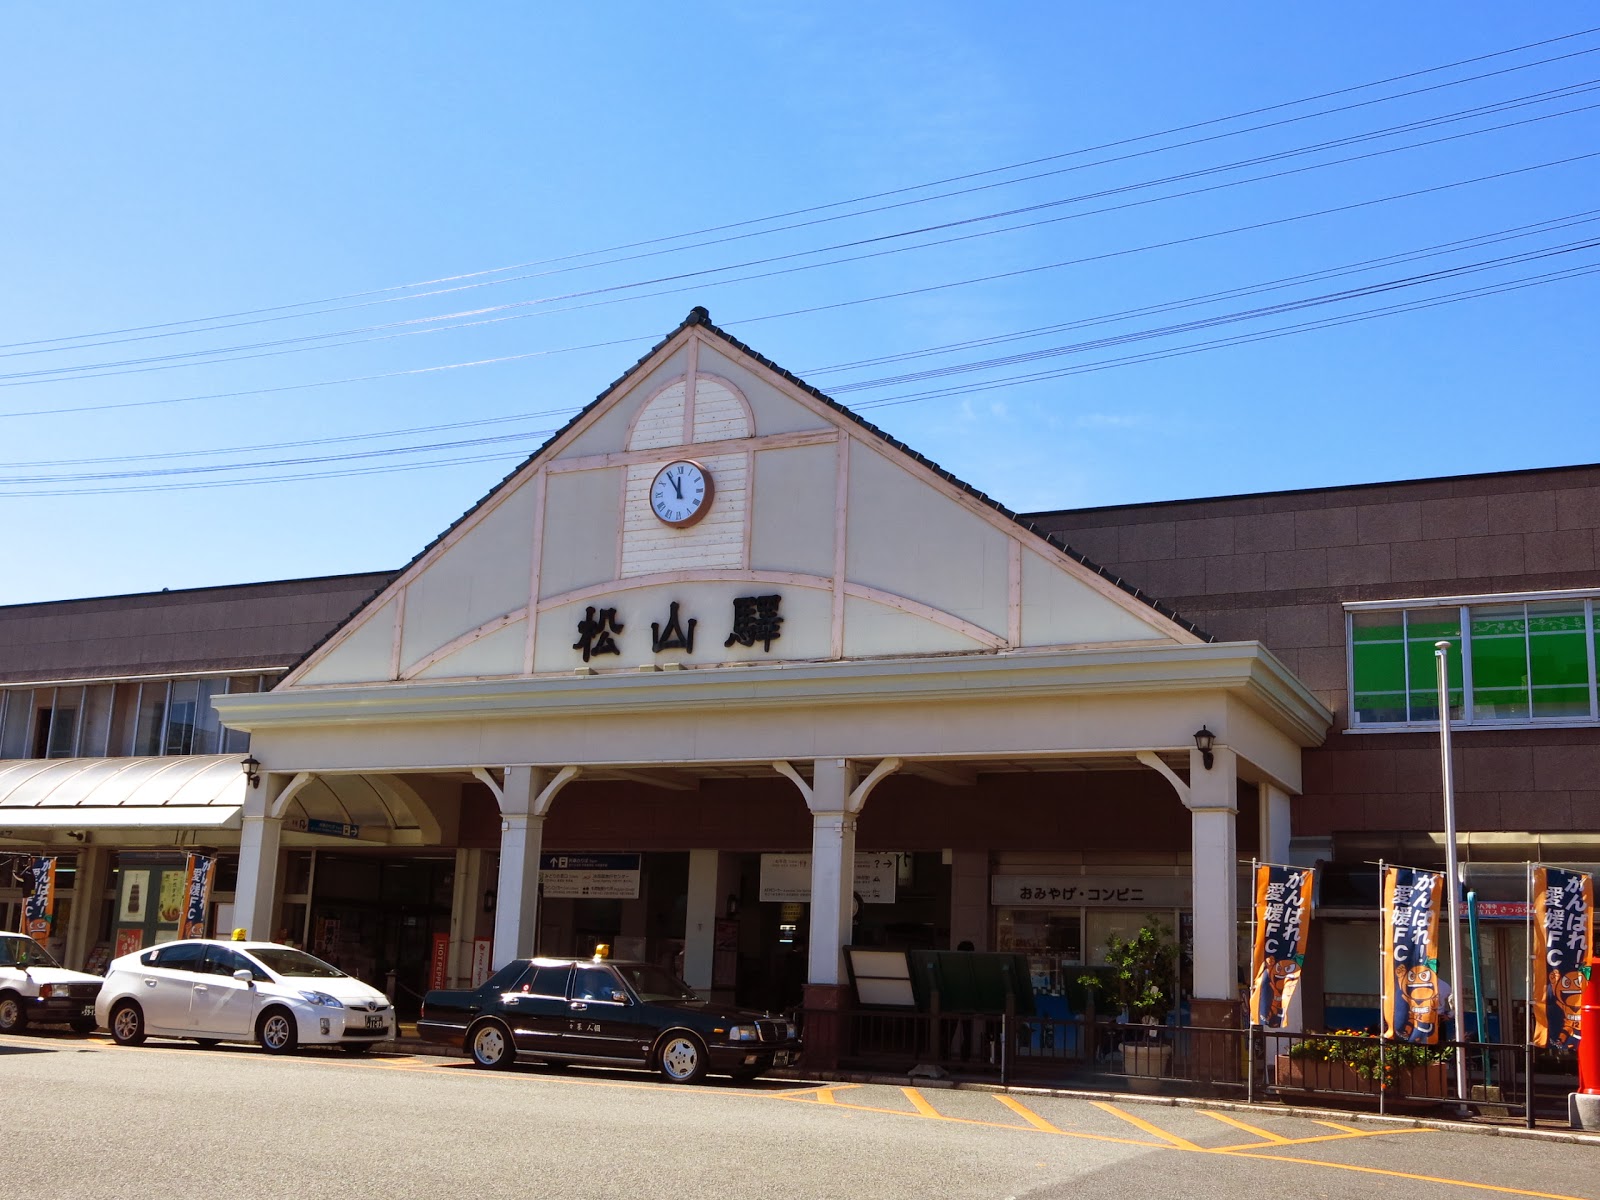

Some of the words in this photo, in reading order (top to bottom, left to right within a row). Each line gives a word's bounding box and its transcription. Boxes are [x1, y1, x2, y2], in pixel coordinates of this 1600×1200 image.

[573, 594, 784, 662] 松山驛
[187, 868, 203, 920] 愛媛FC
[1020, 887, 1144, 901] おみやげ・コンビニ
[1263, 882, 1286, 954] 愛媛FC
[1282, 872, 1307, 958] がんばれ!
[1391, 885, 1414, 962] 愛媛FC
[1411, 874, 1438, 963] がんばれ!
[1544, 886, 1565, 967] 愛媛FC
[1564, 875, 1588, 969] がんばれ!
[437, 943, 445, 961] HOT
